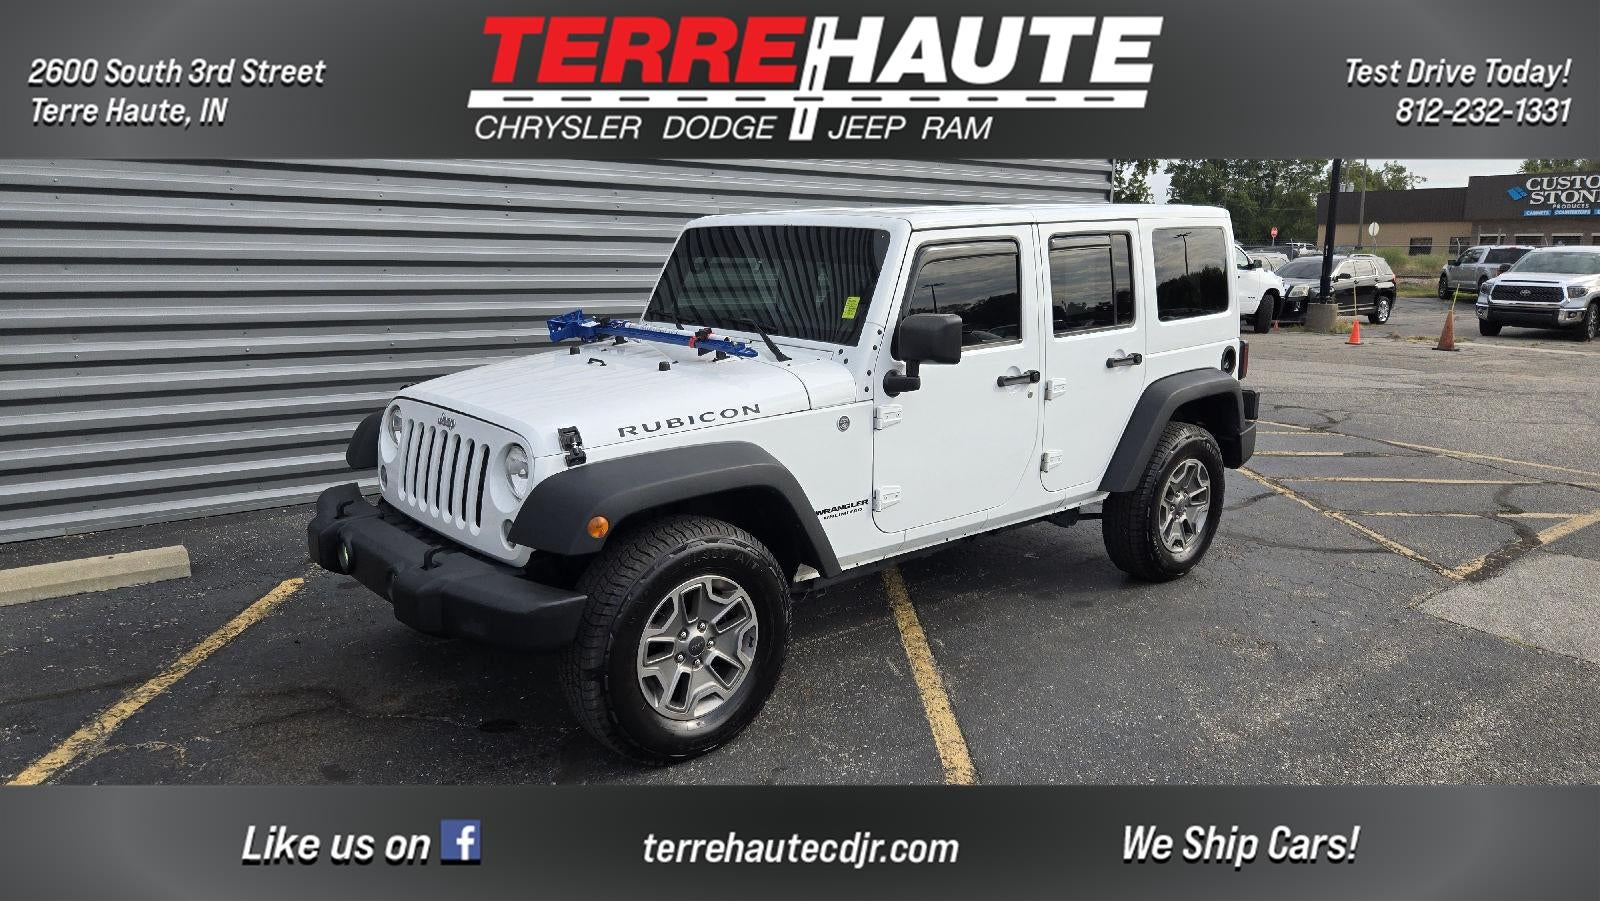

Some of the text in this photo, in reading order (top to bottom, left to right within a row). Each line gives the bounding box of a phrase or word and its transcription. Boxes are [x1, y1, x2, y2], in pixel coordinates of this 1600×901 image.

[1529, 189, 1600, 205] STON
[617, 403, 761, 438] RUBICON
[815, 499, 869, 516] WRANGLER
